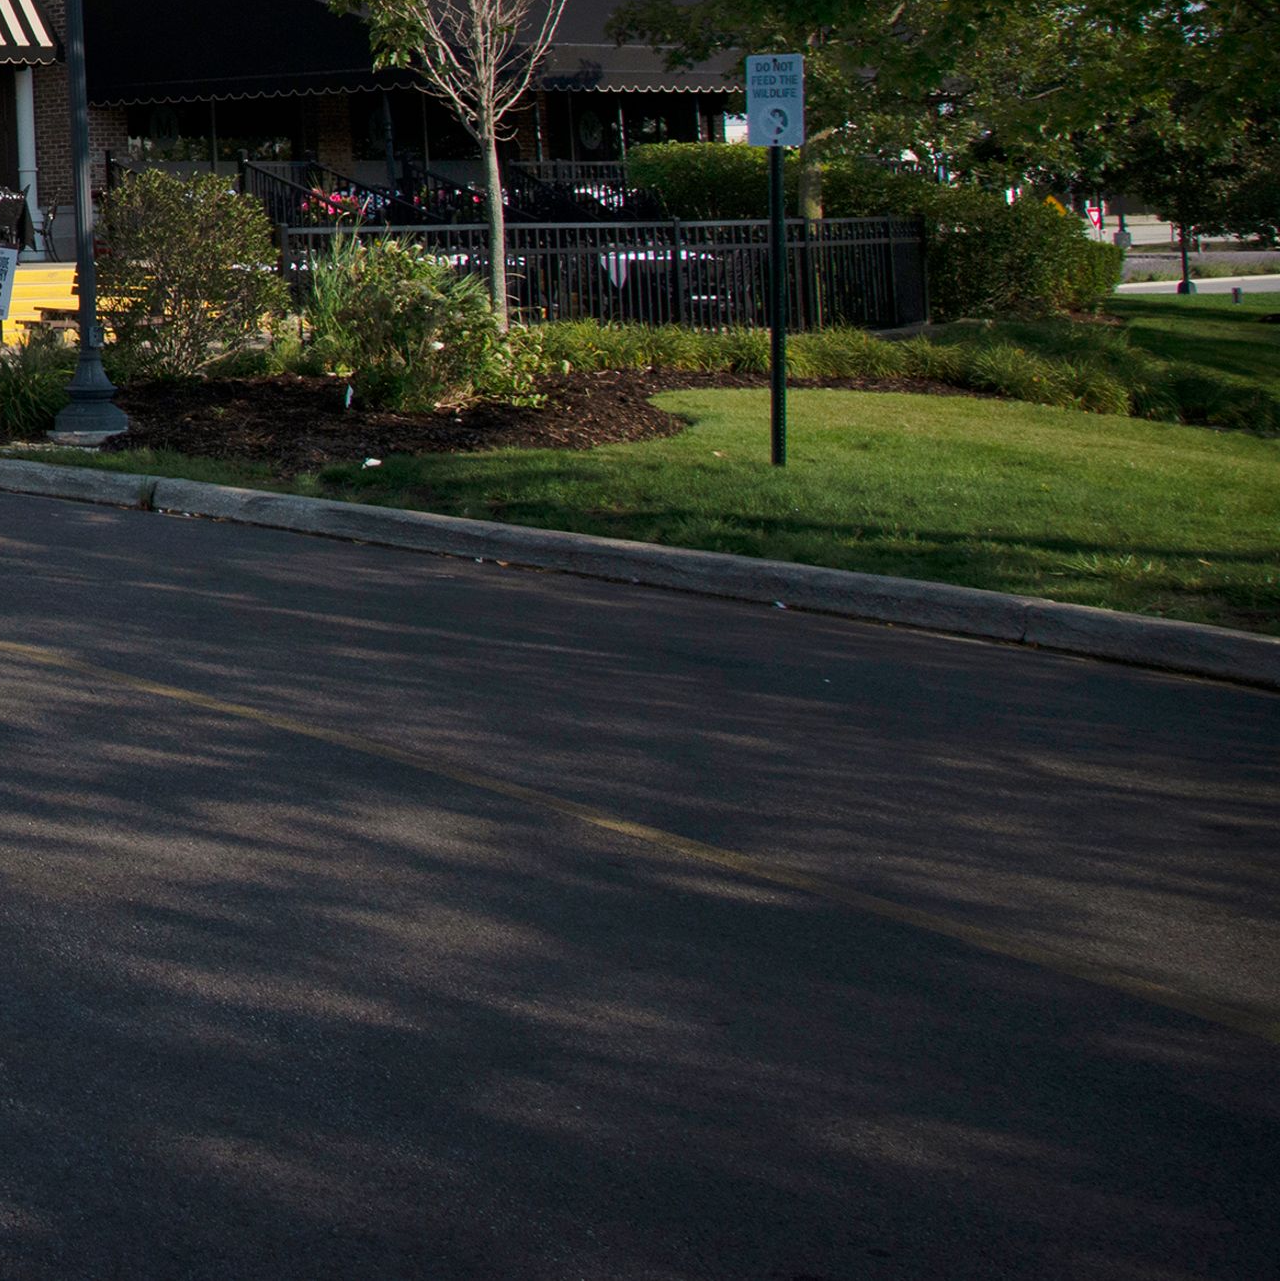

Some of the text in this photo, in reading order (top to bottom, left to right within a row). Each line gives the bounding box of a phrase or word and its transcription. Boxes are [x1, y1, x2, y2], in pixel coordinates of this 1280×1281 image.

[755, 61, 794, 72] DO NOT
[751, 75, 799, 86] FEED THE
[752, 88, 797, 99] WILDLIFE
